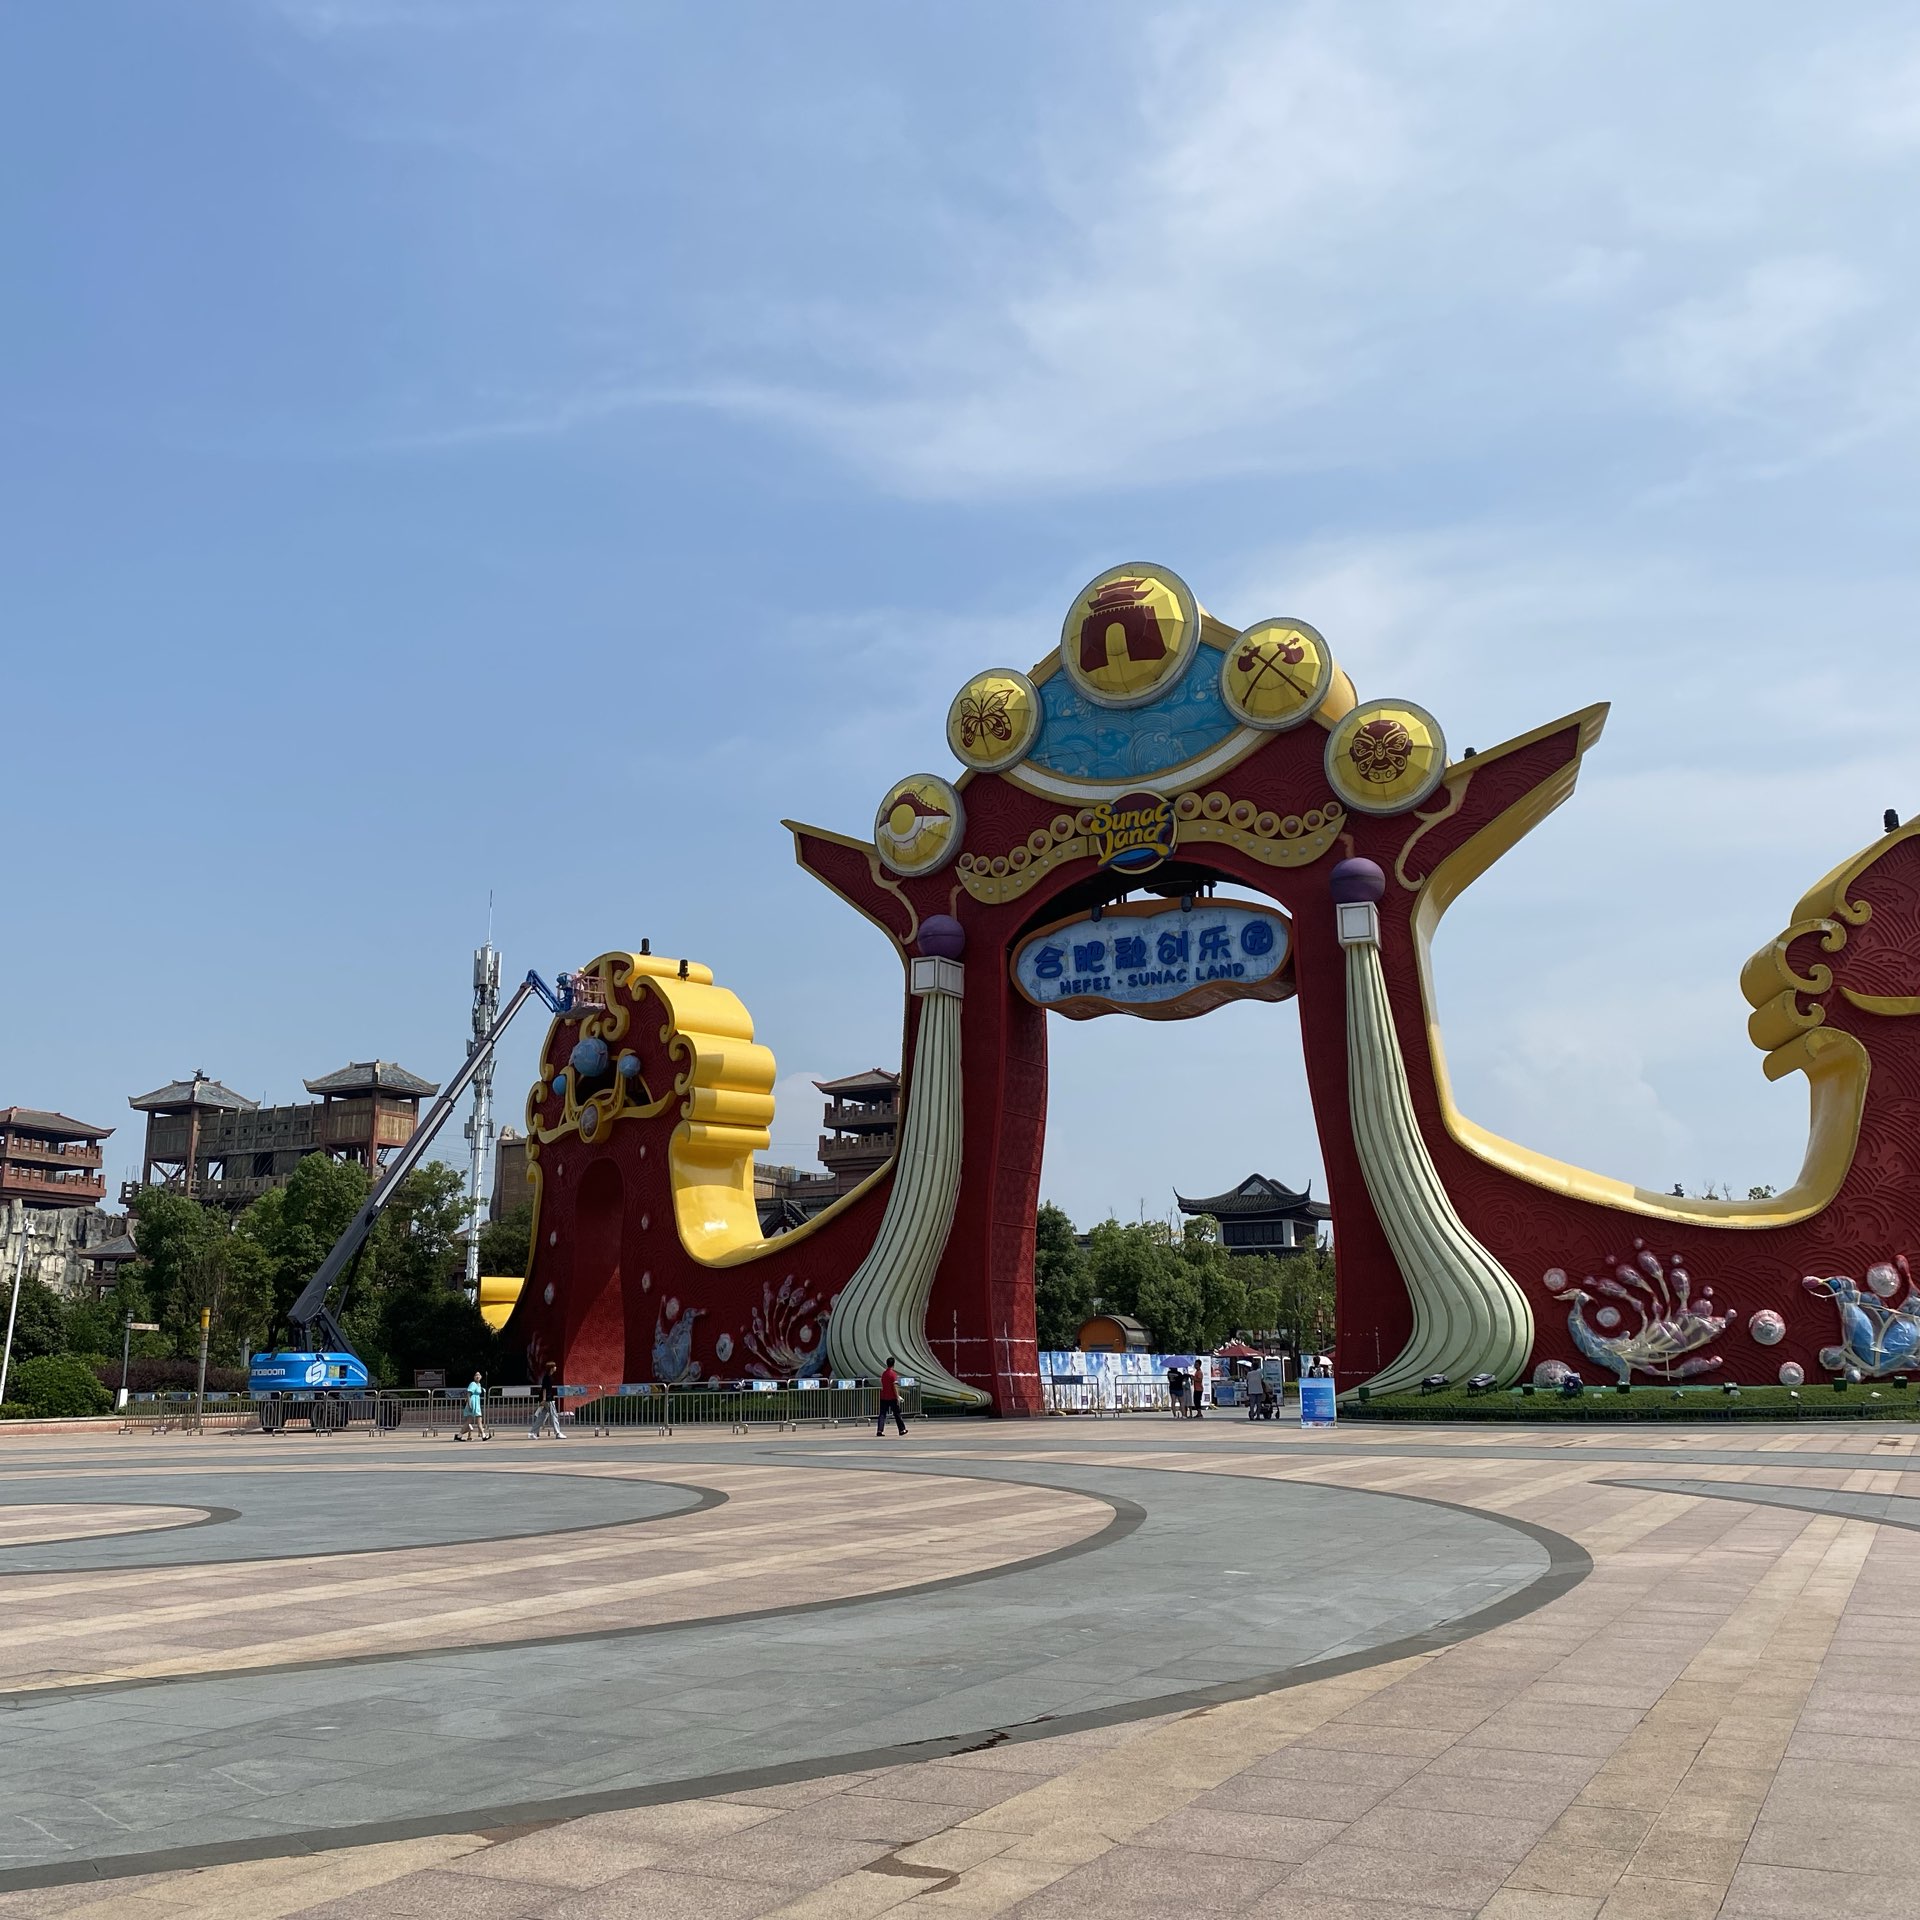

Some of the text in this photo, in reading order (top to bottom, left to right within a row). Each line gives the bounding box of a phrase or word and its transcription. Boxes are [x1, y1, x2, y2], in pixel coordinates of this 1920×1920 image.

[1090, 802, 1169, 834] Sunac
[1097, 822, 1168, 865] Land
[1034, 920, 1274, 979] 合肥融创乐园
[1060, 962, 1245, 994] HEFEI SUNAC LAND
